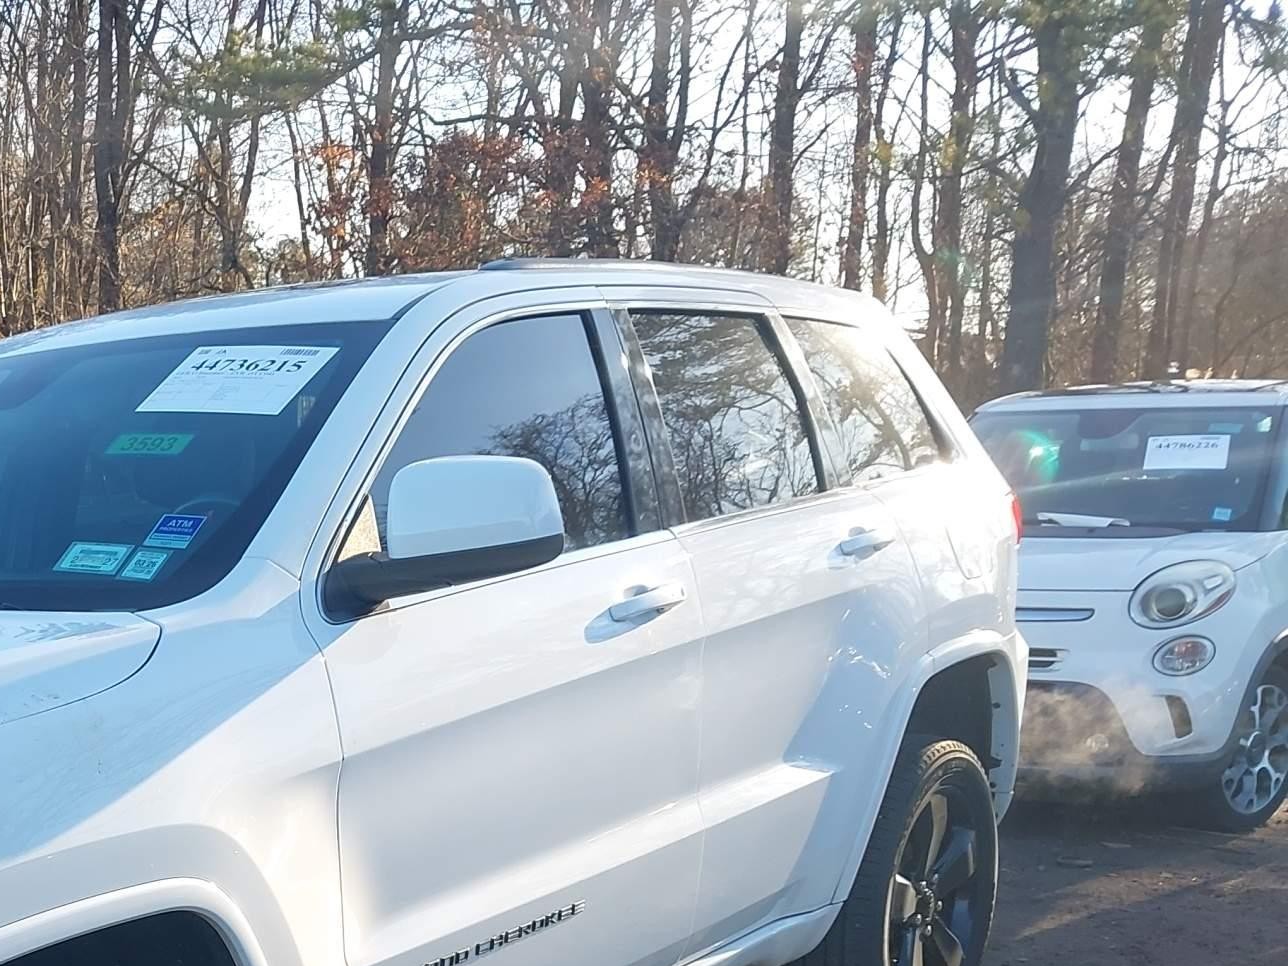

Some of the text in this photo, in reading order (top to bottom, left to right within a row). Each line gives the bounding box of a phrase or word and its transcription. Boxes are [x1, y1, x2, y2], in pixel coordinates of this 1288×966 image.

[191, 359, 307, 373] 44736215
[120, 436, 178, 451] 3593
[167, 519, 194, 528] ATM
[475, 898, 587, 957] CHEROKEE
